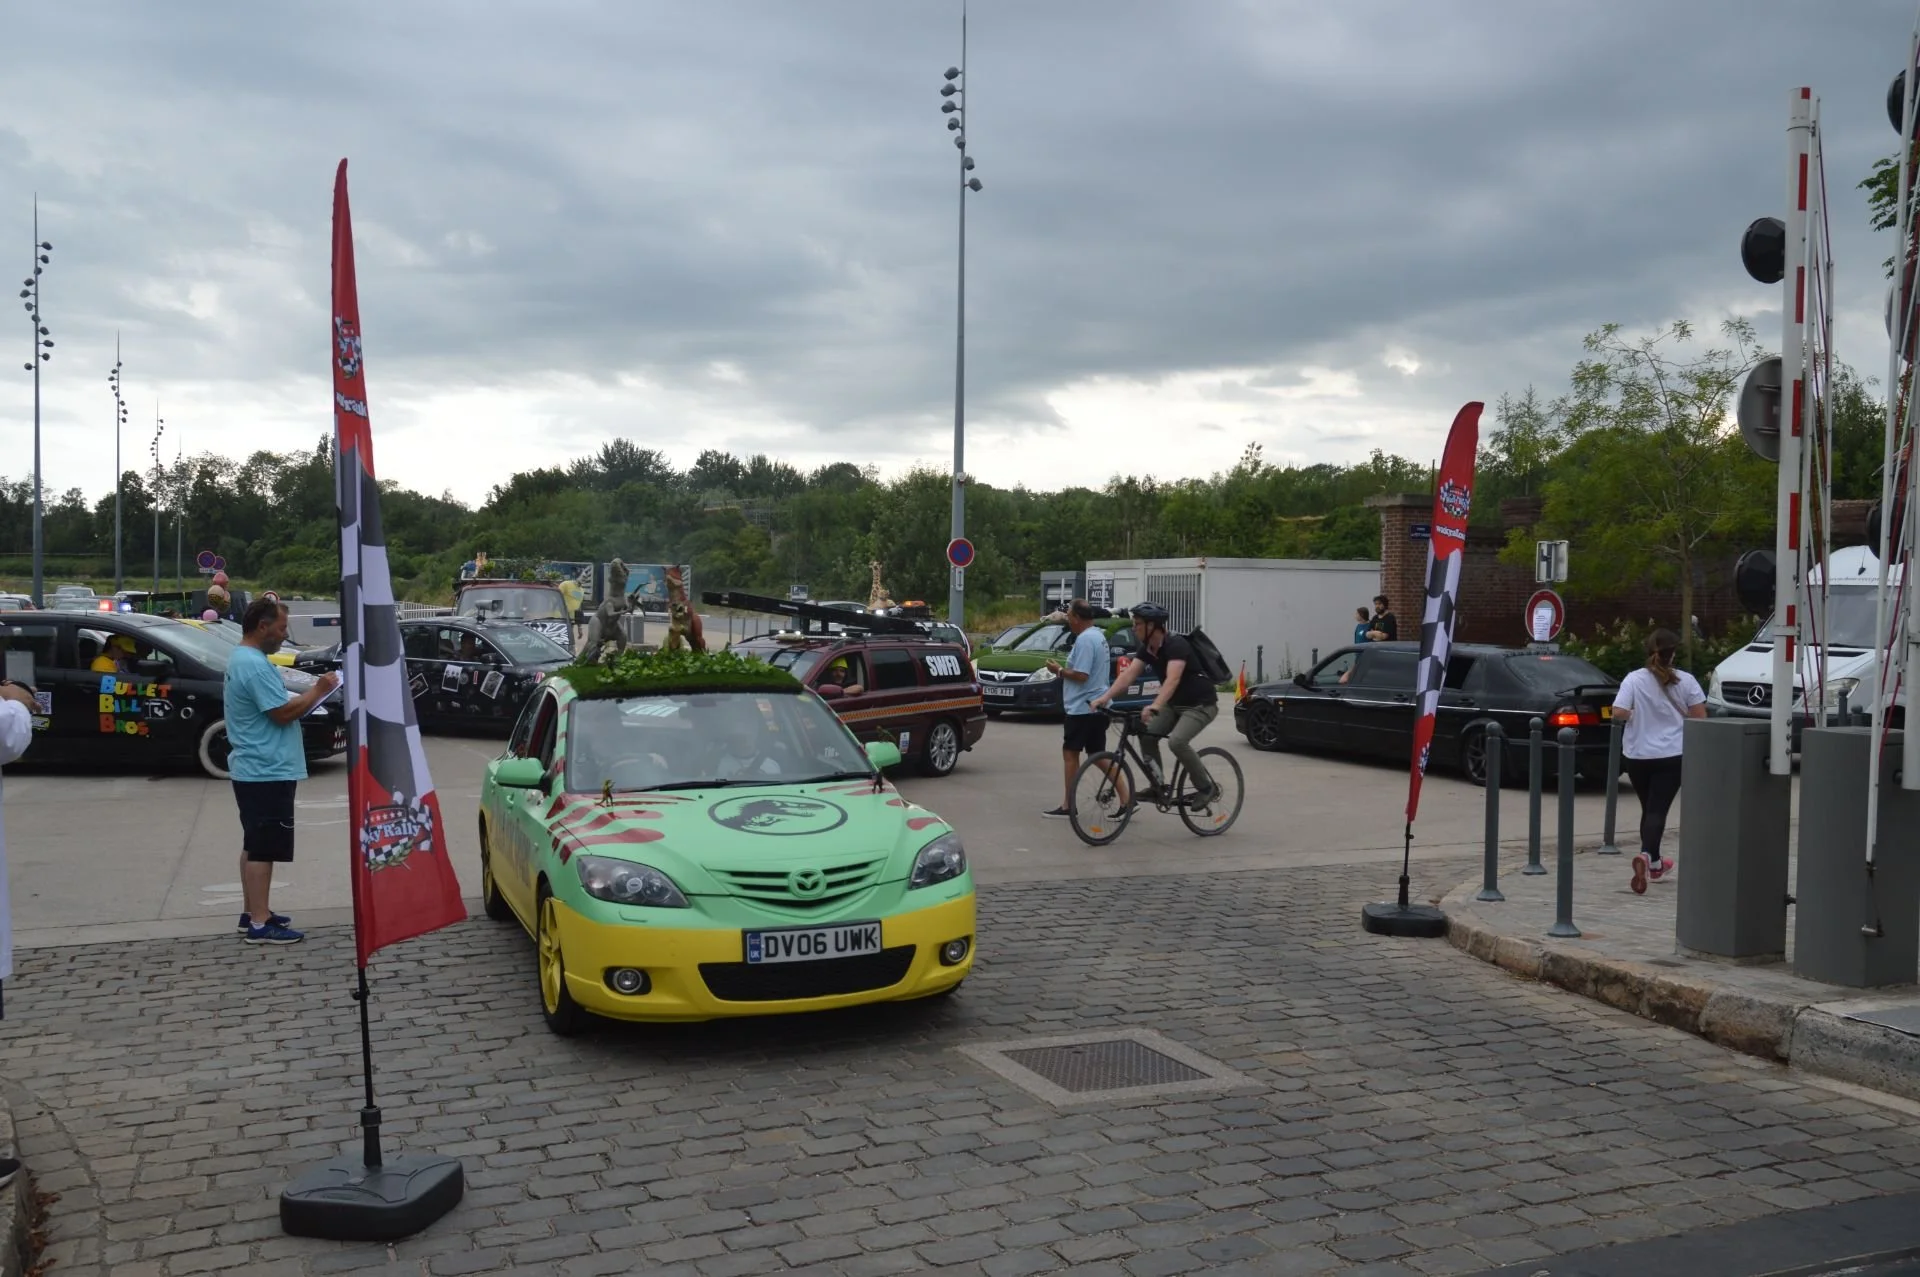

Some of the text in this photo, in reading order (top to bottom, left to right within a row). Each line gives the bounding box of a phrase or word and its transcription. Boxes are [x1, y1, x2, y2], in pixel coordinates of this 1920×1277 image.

[925, 655, 961, 677] SWFD
[100, 675, 172, 698] BULLET
[100, 694, 142, 713] BILL
[383, 821, 421, 838] Rally
[764, 926, 877, 958] DV06 UWK
[750, 950, 760, 959] UK
